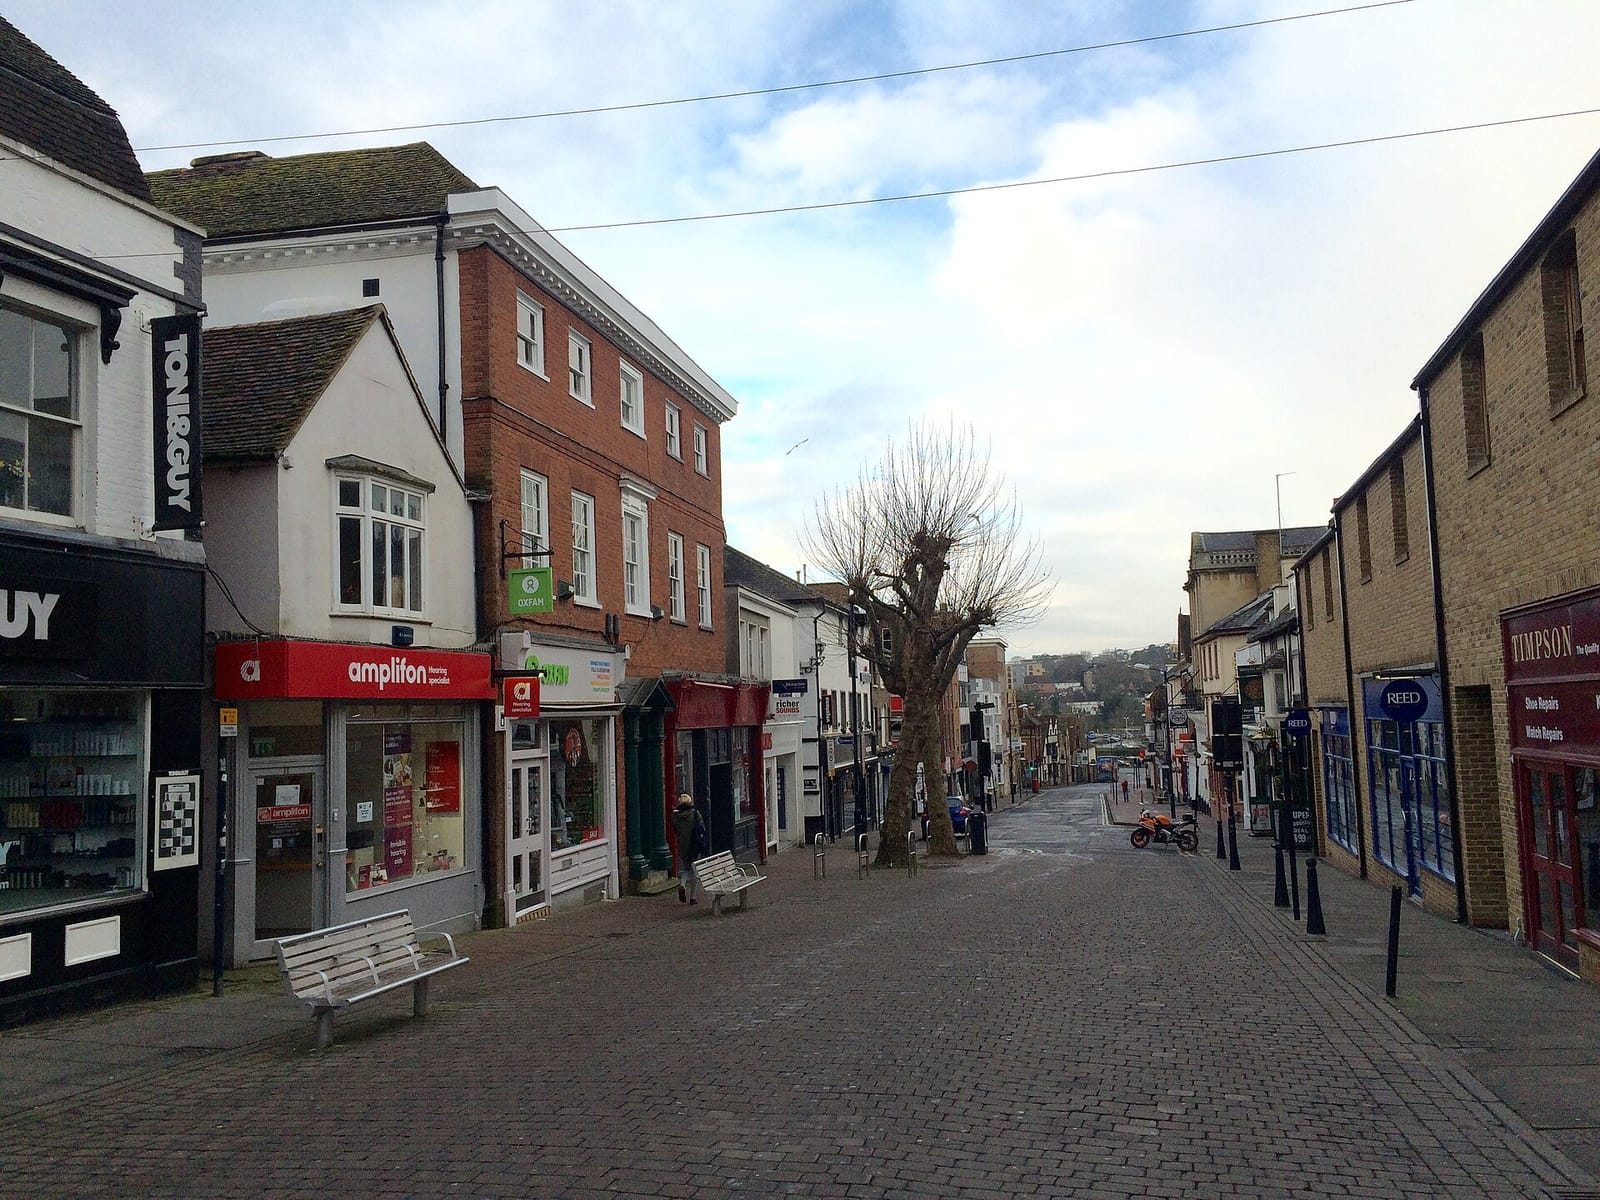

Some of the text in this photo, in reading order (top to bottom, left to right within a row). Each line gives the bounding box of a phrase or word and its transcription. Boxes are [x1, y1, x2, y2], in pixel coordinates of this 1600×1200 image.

[163, 333, 191, 512] TONI&GUY
[518, 598, 544, 607] OXFAM
[1511, 625, 1572, 662] TIMPSON
[1576, 645, 1584, 655] The
[348, 656, 427, 691] amplifon
[428, 666, 448, 676] Hearing
[776, 699, 800, 708] richer
[1387, 692, 1421, 705] REED
[1525, 695, 1559, 713] Shoe Repairs
[1288, 719, 1308, 728] REED
[1525, 725, 1564, 743] Watch Repairs
[272, 807, 309, 818] amplifon
